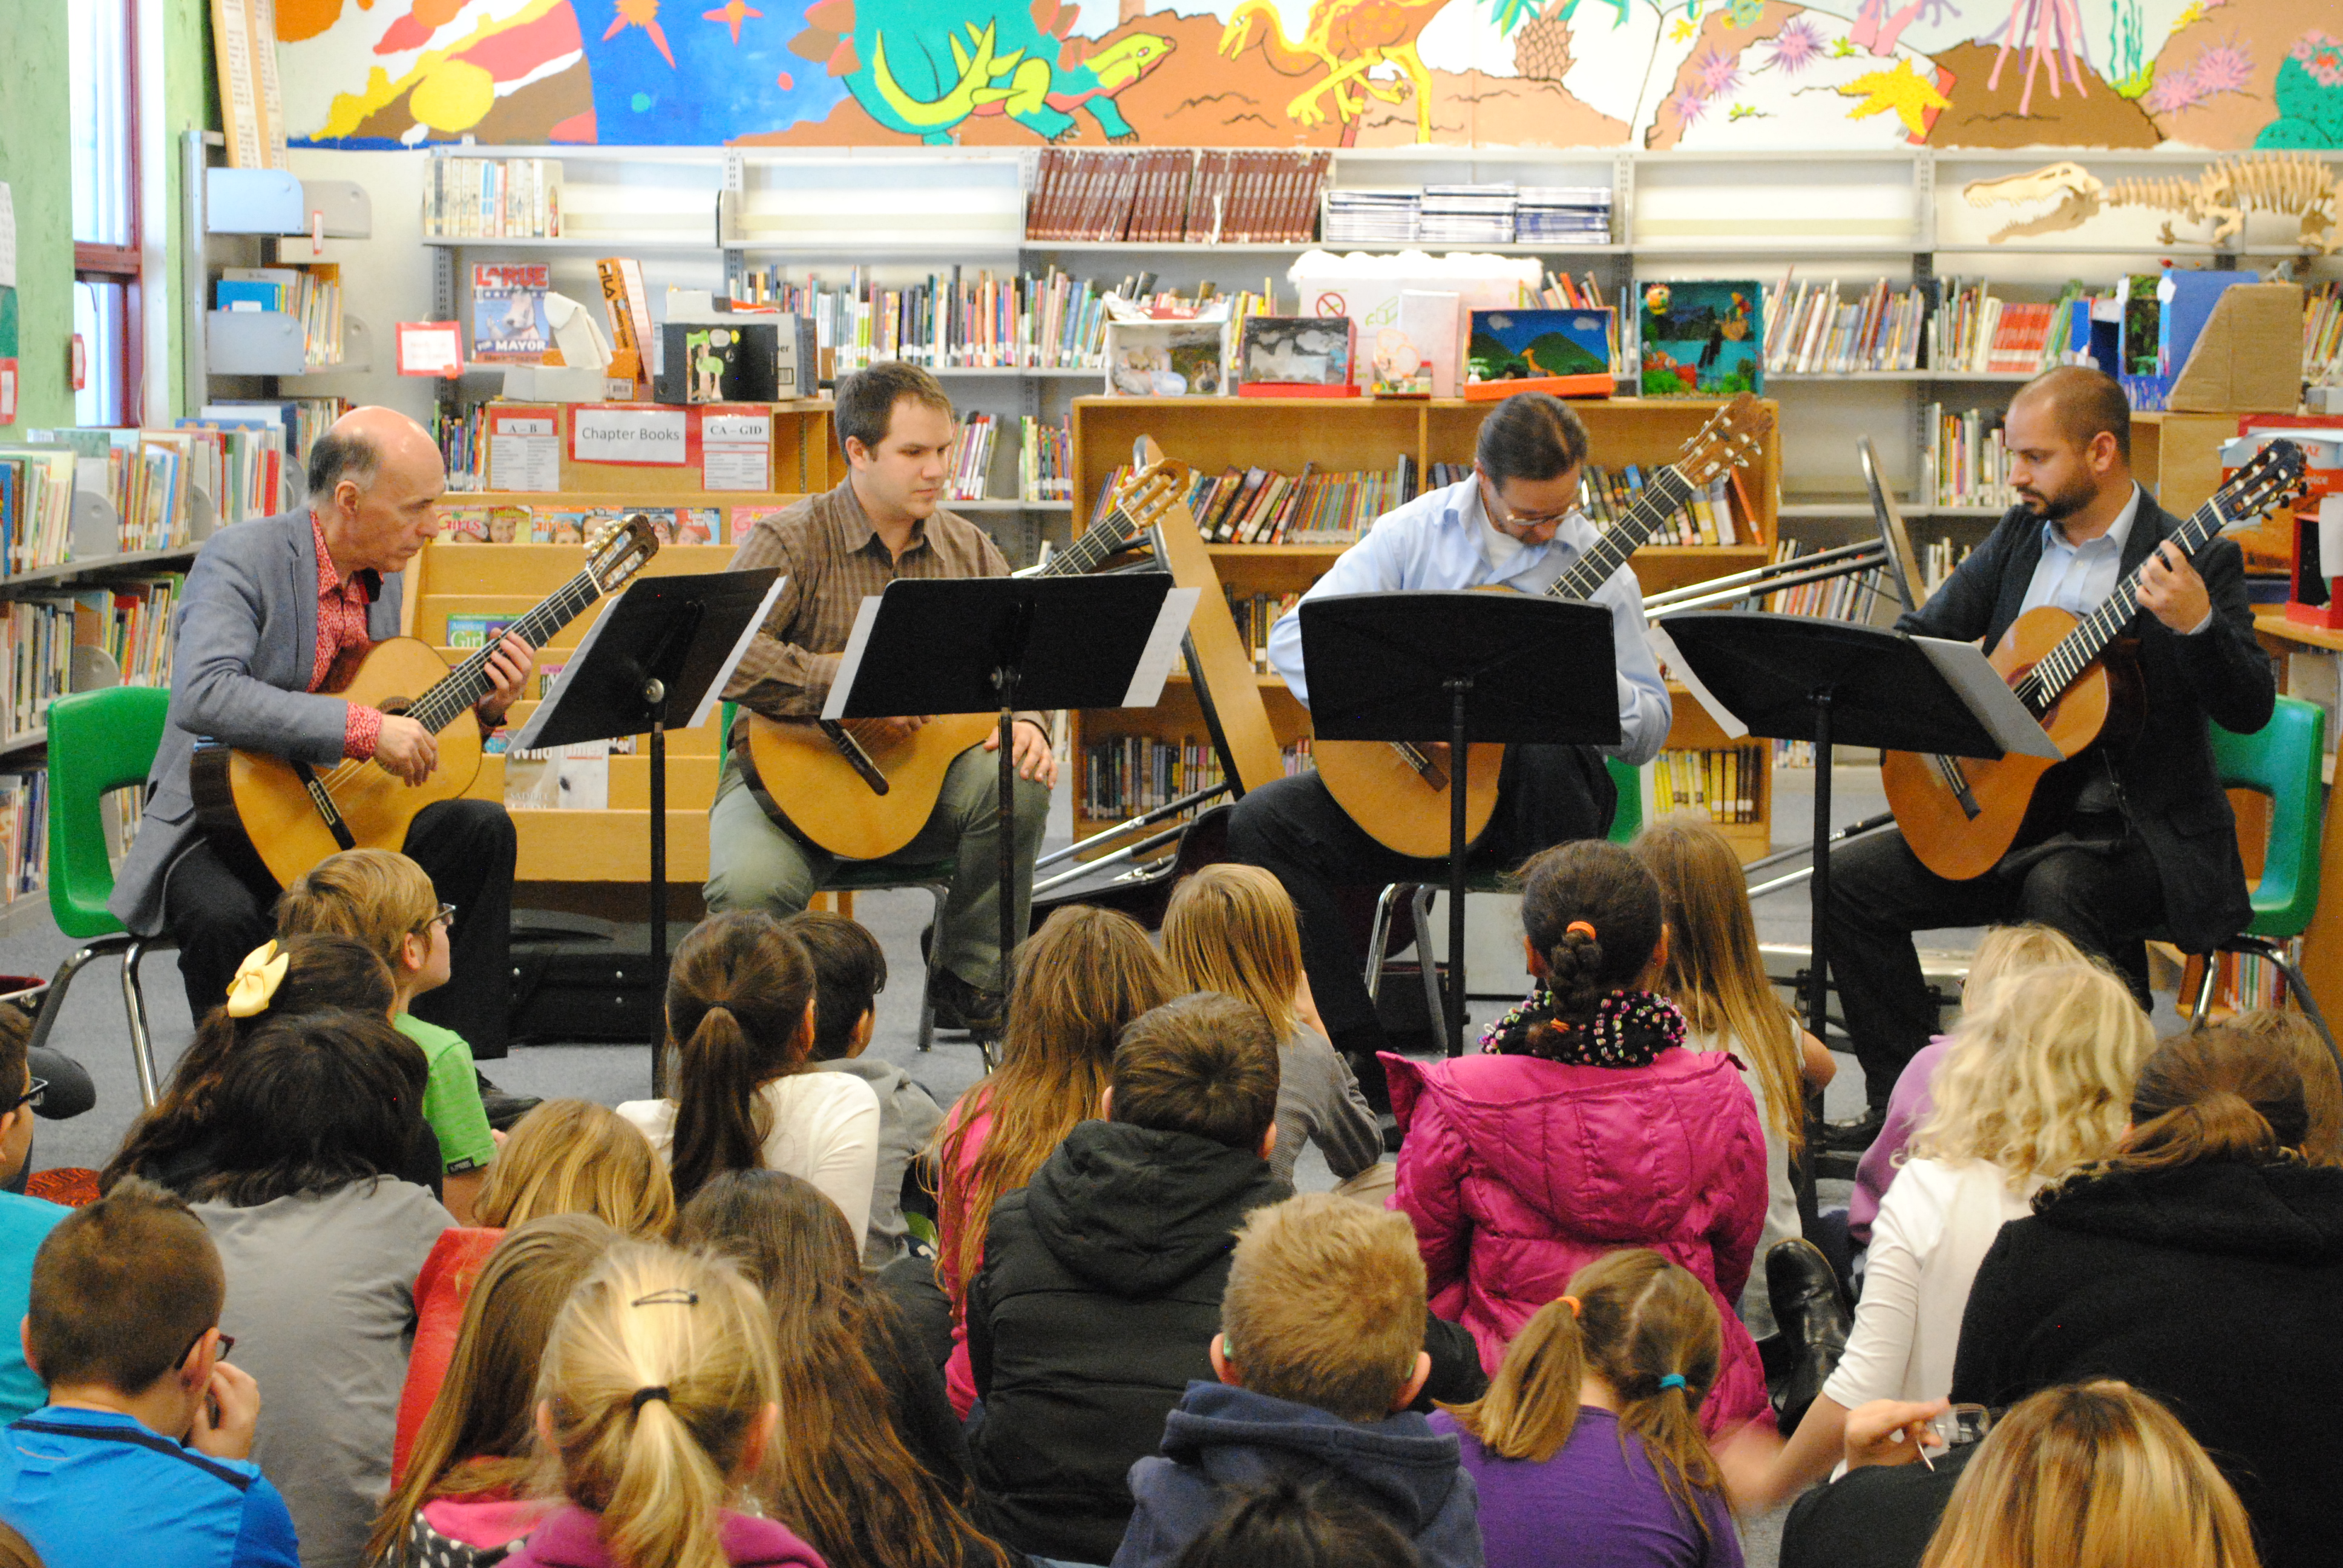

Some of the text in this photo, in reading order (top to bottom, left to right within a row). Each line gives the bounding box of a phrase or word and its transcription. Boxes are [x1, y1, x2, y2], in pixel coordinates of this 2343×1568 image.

[496, 340, 545, 351] MAYOR
[509, 425, 516, 433] A
[582, 426, 680, 442] Chapter Books
[710, 425, 727, 434] CA
[739, 426, 762, 435] GID
[451, 630, 484, 647] Girl
